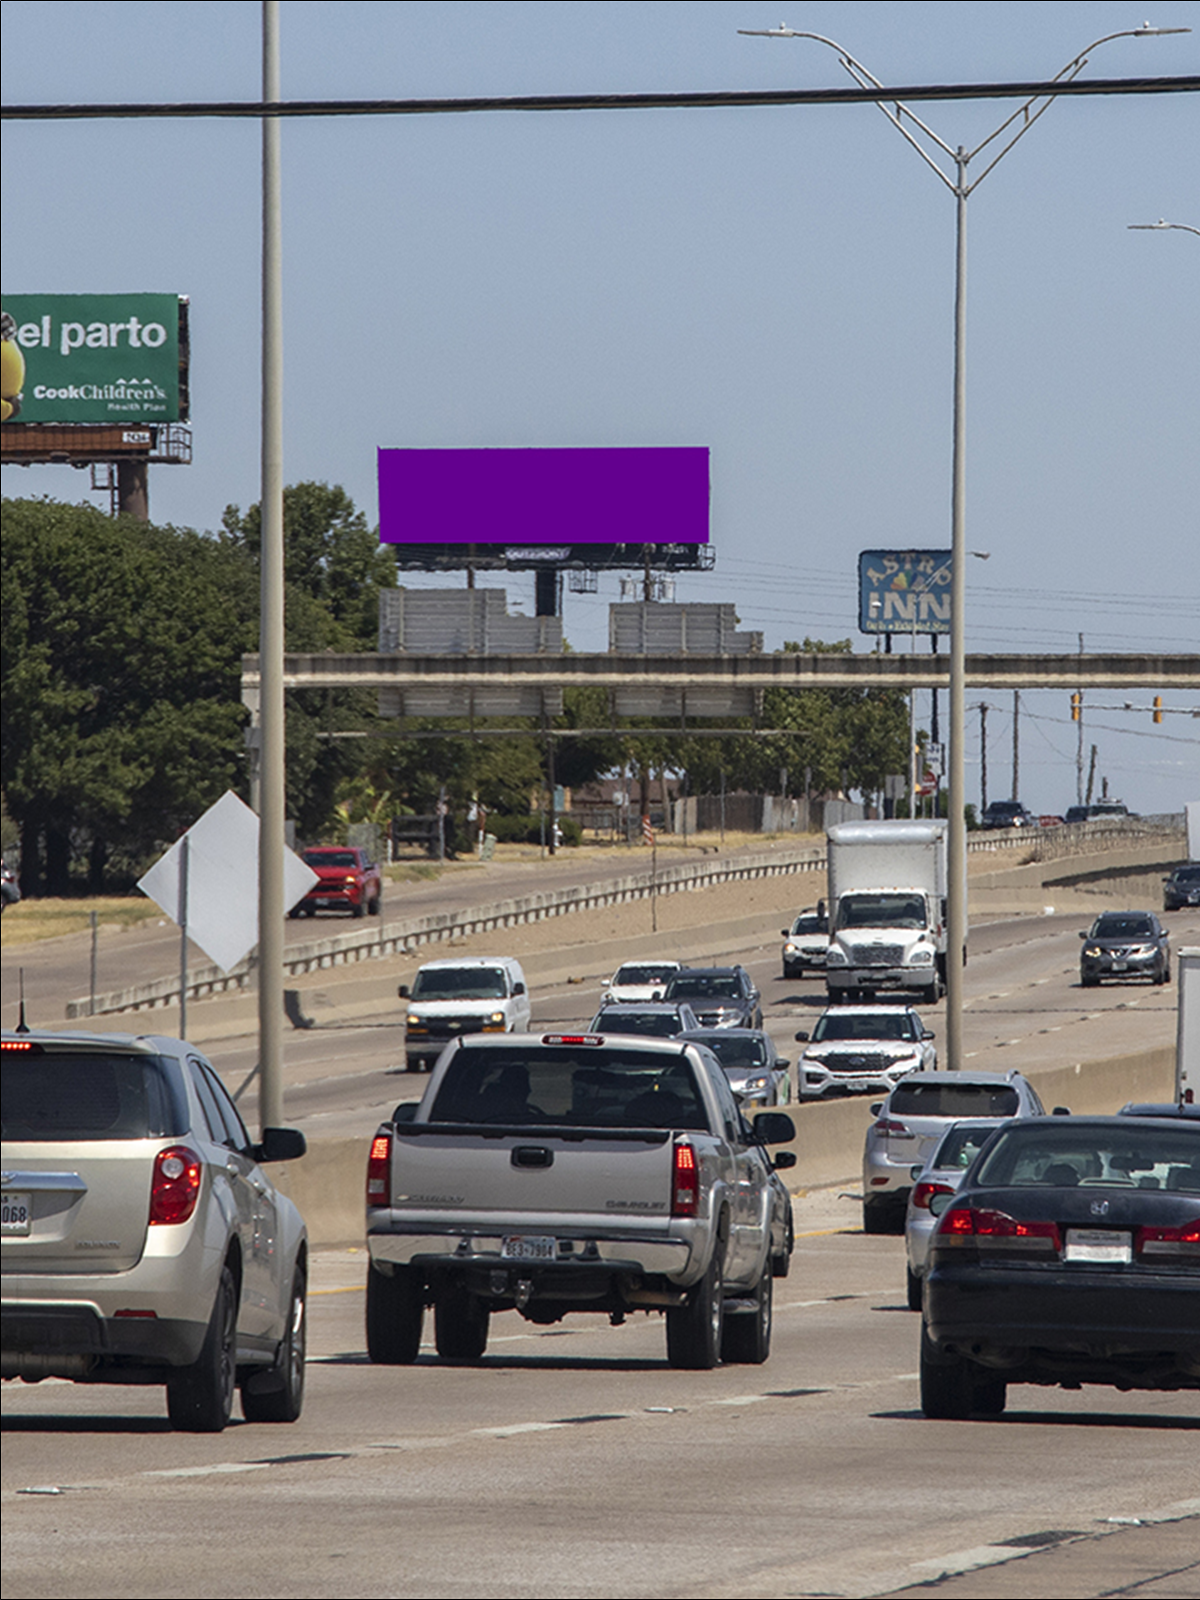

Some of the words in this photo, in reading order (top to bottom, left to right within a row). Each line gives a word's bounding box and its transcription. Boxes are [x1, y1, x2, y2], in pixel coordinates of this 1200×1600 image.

[18, 315, 51, 348] el
[60, 316, 168, 356] parto
[868, 591, 951, 619] INN
